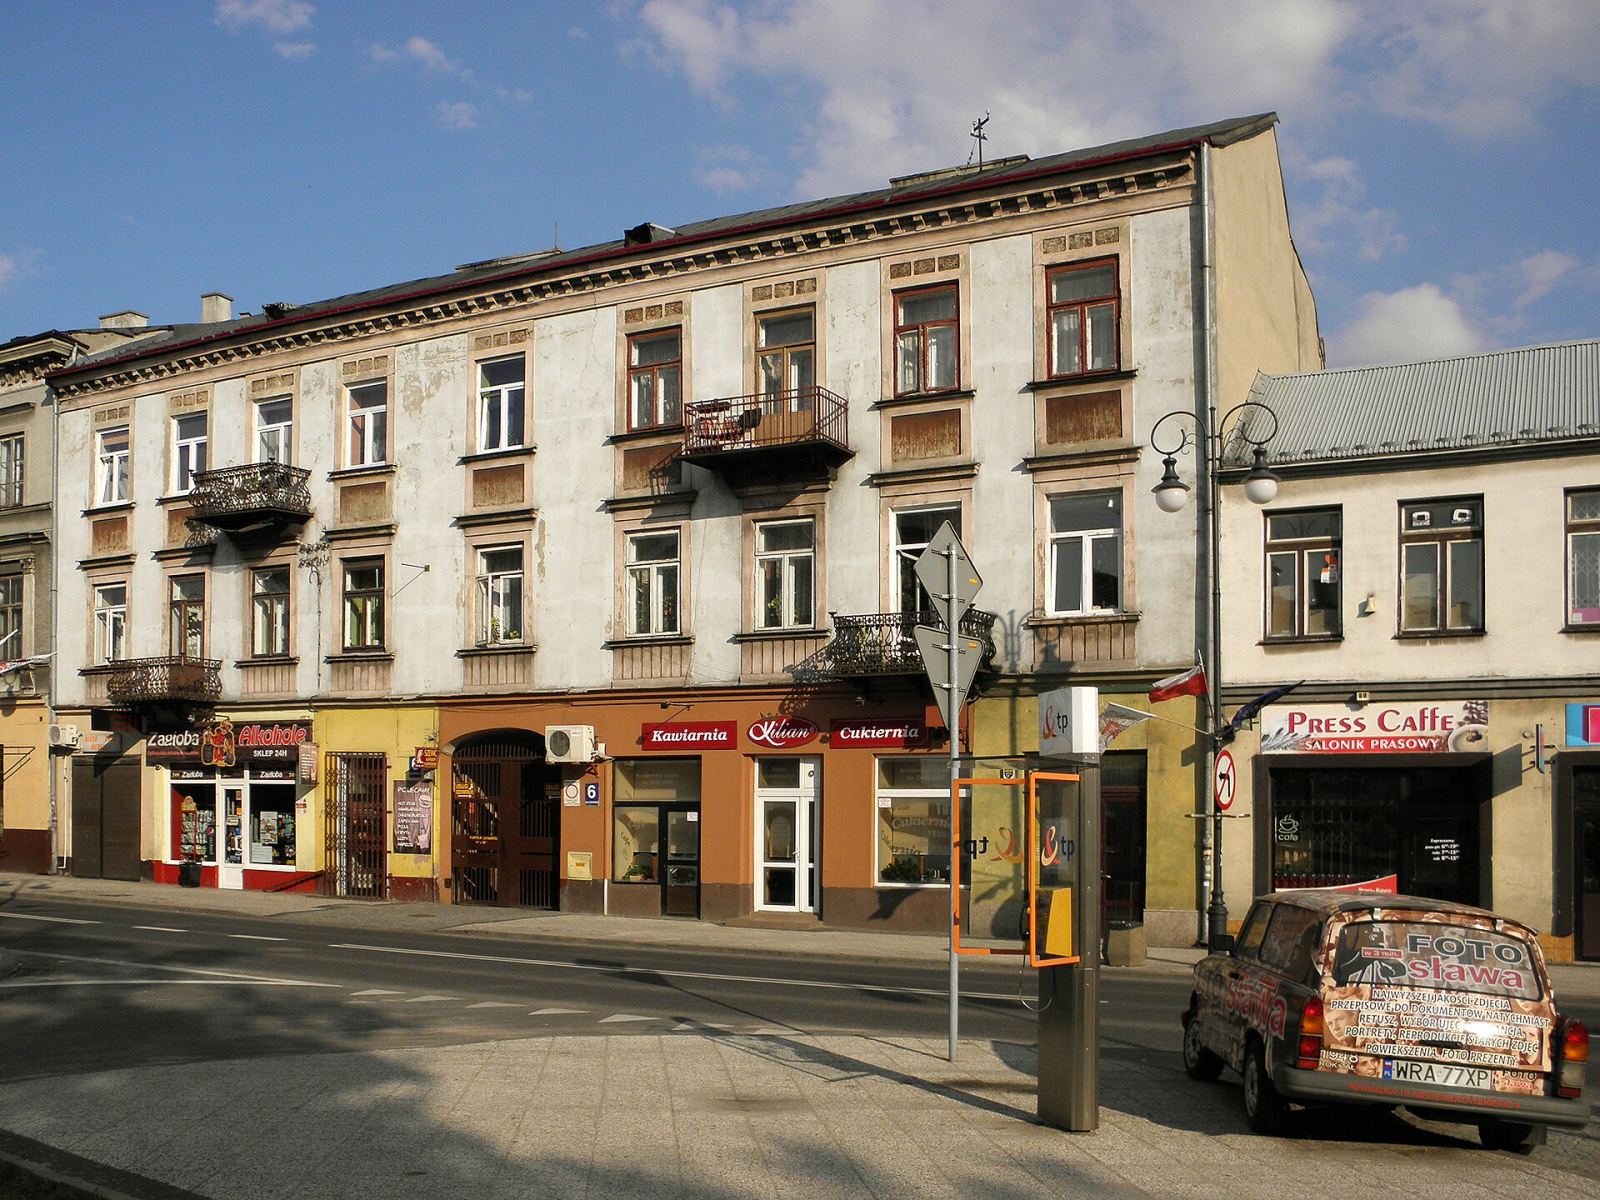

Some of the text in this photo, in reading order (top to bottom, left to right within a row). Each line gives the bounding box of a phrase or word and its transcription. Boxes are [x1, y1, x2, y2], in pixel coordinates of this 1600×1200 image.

[1056, 712, 1069, 734] tp
[1288, 706, 1454, 734] Press Caffe
[238, 724, 306, 746] Alkohole
[651, 729, 728, 742] Kawiarnia
[840, 726, 919, 740] Cukiernia
[1305, 738, 1439, 750] SALONIK PRASOWY
[587, 785, 597, 799] 6
[1278, 833, 1299, 841] cafe
[1061, 836, 1075, 861] tp
[1407, 934, 1523, 964] FOTO
[1408, 956, 1523, 989] sława
[1394, 1003, 1409, 1012] DO
[1485, 1011, 1551, 1027] NATYCHMIAST
[1467, 1036, 1510, 1049] STARYCH
[1320, 1050, 1359, 1063] 1948
[1442, 1050, 1468, 1060] FOTO
[1396, 1063, 1439, 1082] WRA
[1442, 1067, 1488, 1087] 77XP
[1502, 1069, 1537, 1081] FOTO
